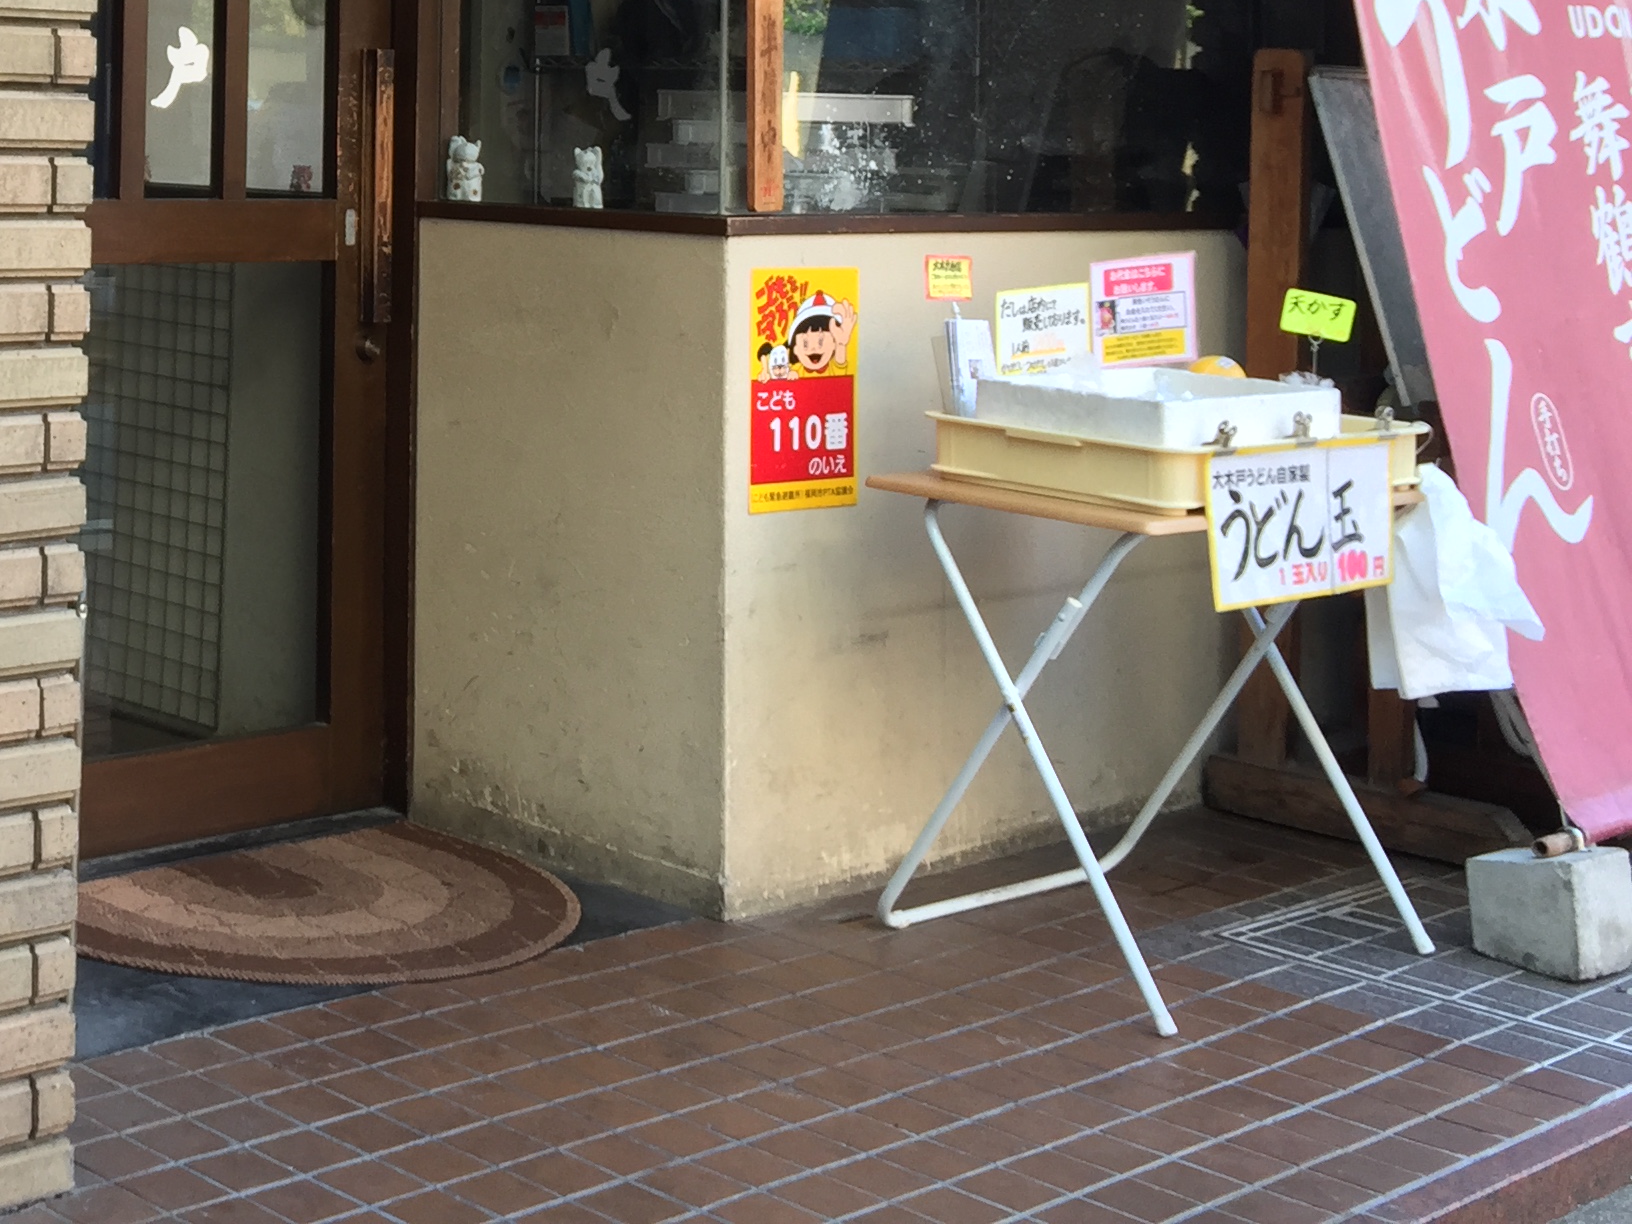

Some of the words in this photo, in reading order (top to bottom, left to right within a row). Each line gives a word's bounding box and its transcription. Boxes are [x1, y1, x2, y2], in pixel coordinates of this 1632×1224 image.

[1288, 295, 1346, 321] 天かす
[756, 390, 796, 411] こども
[770, 412, 848, 452] 110番
[1538, 400, 1567, 482] 手打ち
[808, 455, 847, 476] のいえ
[1212, 464, 1311, 489] 大木戸うどん自家製
